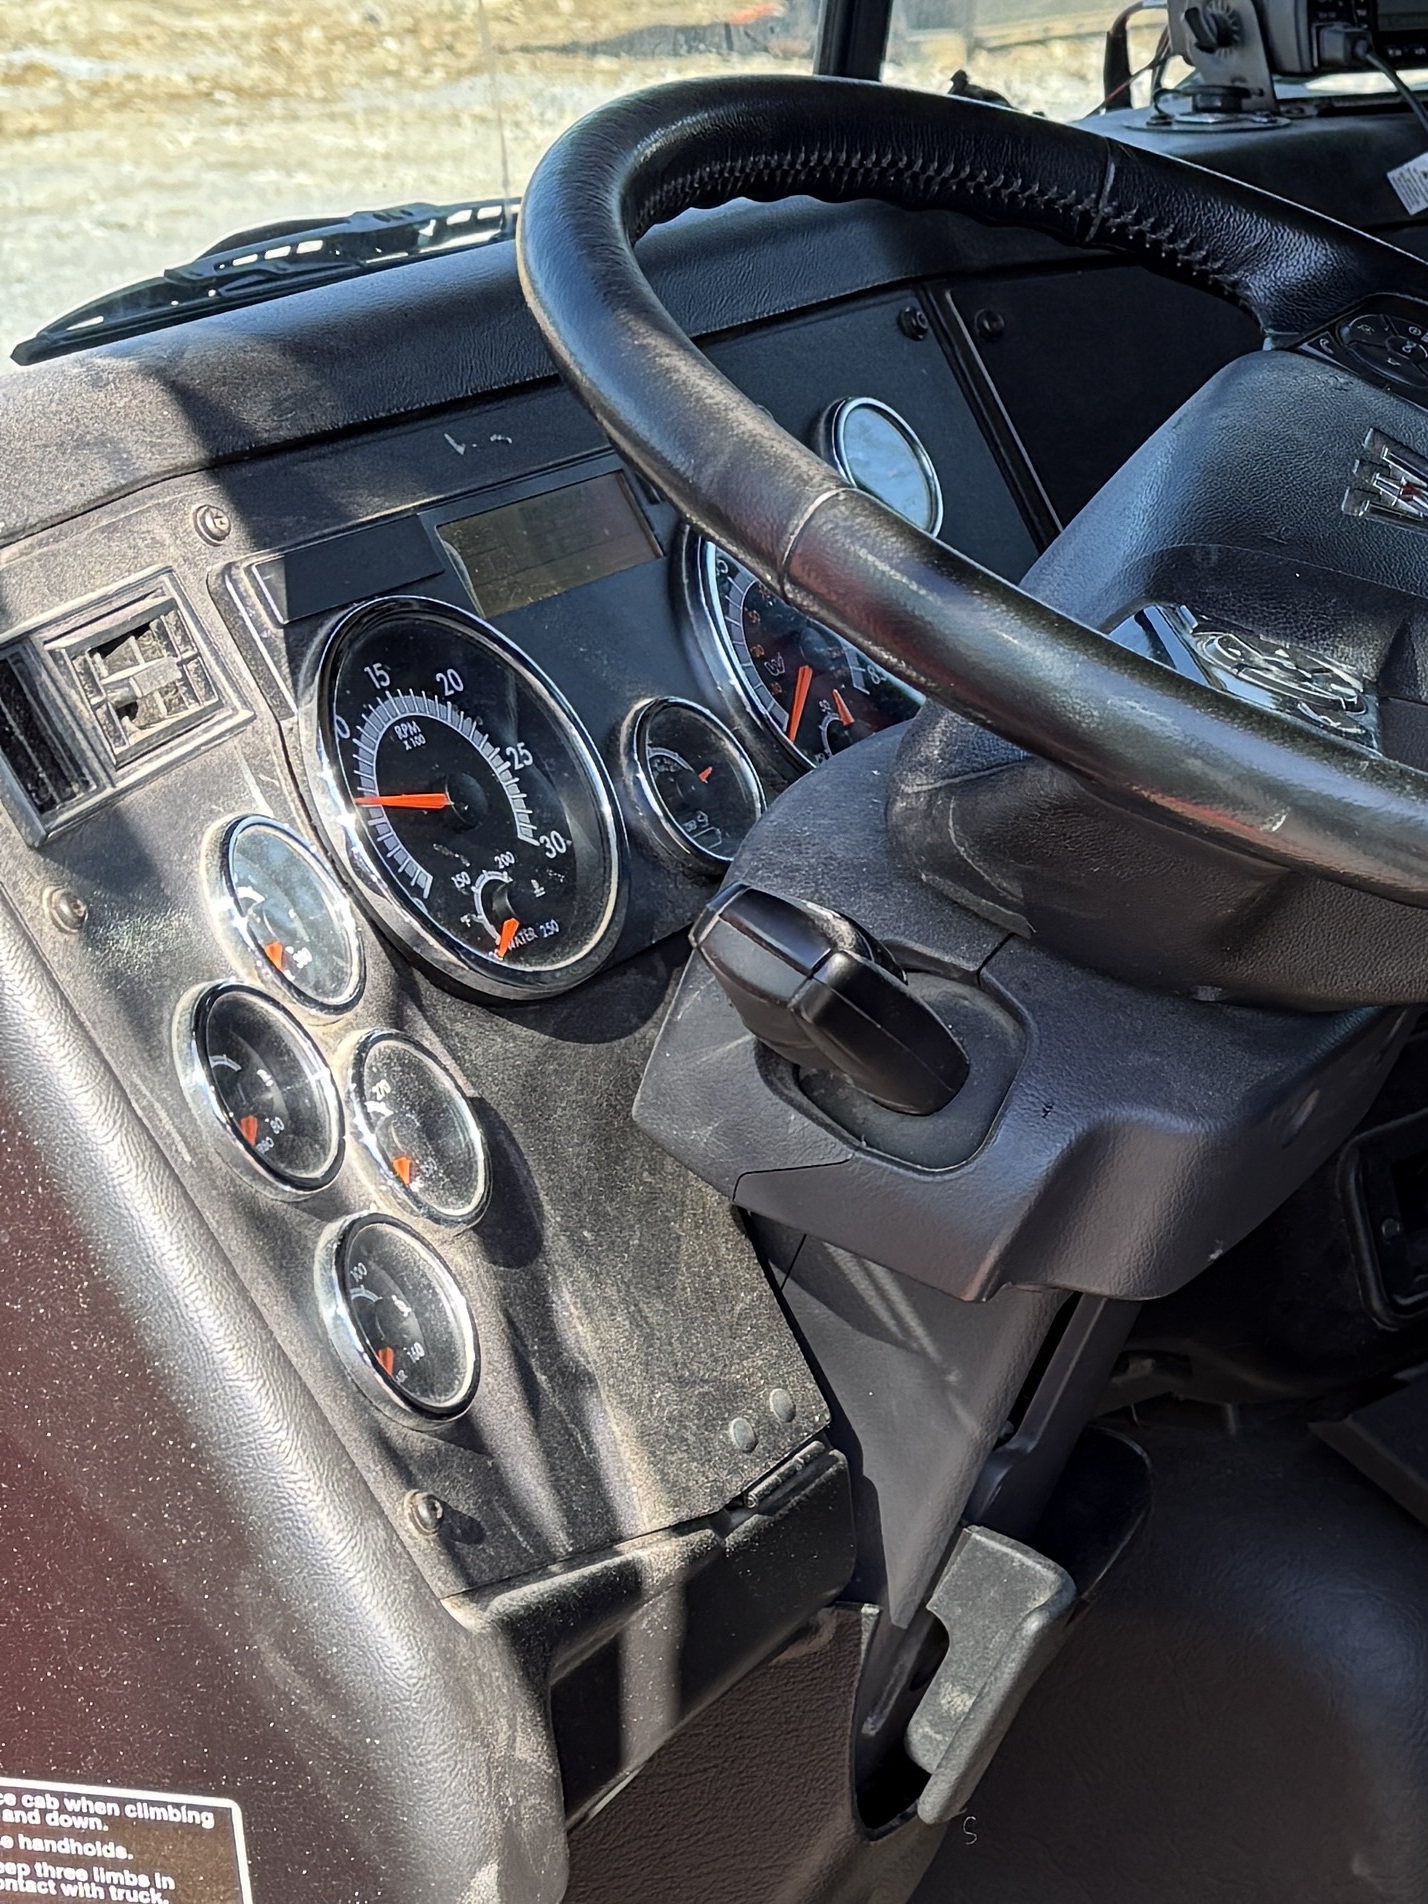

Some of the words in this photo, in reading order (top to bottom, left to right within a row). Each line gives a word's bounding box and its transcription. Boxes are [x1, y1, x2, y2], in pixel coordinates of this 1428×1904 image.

[364, 661, 391, 690] 15
[436, 668, 464, 697] 20
[393, 720, 421, 742] RPM
[505, 741, 534, 772] 25
[493, 850, 516, 868] 200
[539, 829, 568, 860] 30
[450, 870, 472, 890] 150
[507, 925, 539, 951] WATER
[540, 918, 560, 938] 250
[2, 1808, 41, 1825] and
[45, 1810, 109, 1832] down.
[21, 1793, 60, 1810] cab
[63, 1796, 120, 1817] when
[124, 1801, 215, 1829] climbing
[18, 1833, 134, 1860] handholds.
[34, 1861, 88, 1882] three
[93, 1866, 150, 1887] limbs
[155, 1872, 176, 1890] in
[60, 1882, 105, 1900] with
[109, 1885, 169, 1904] truck.
